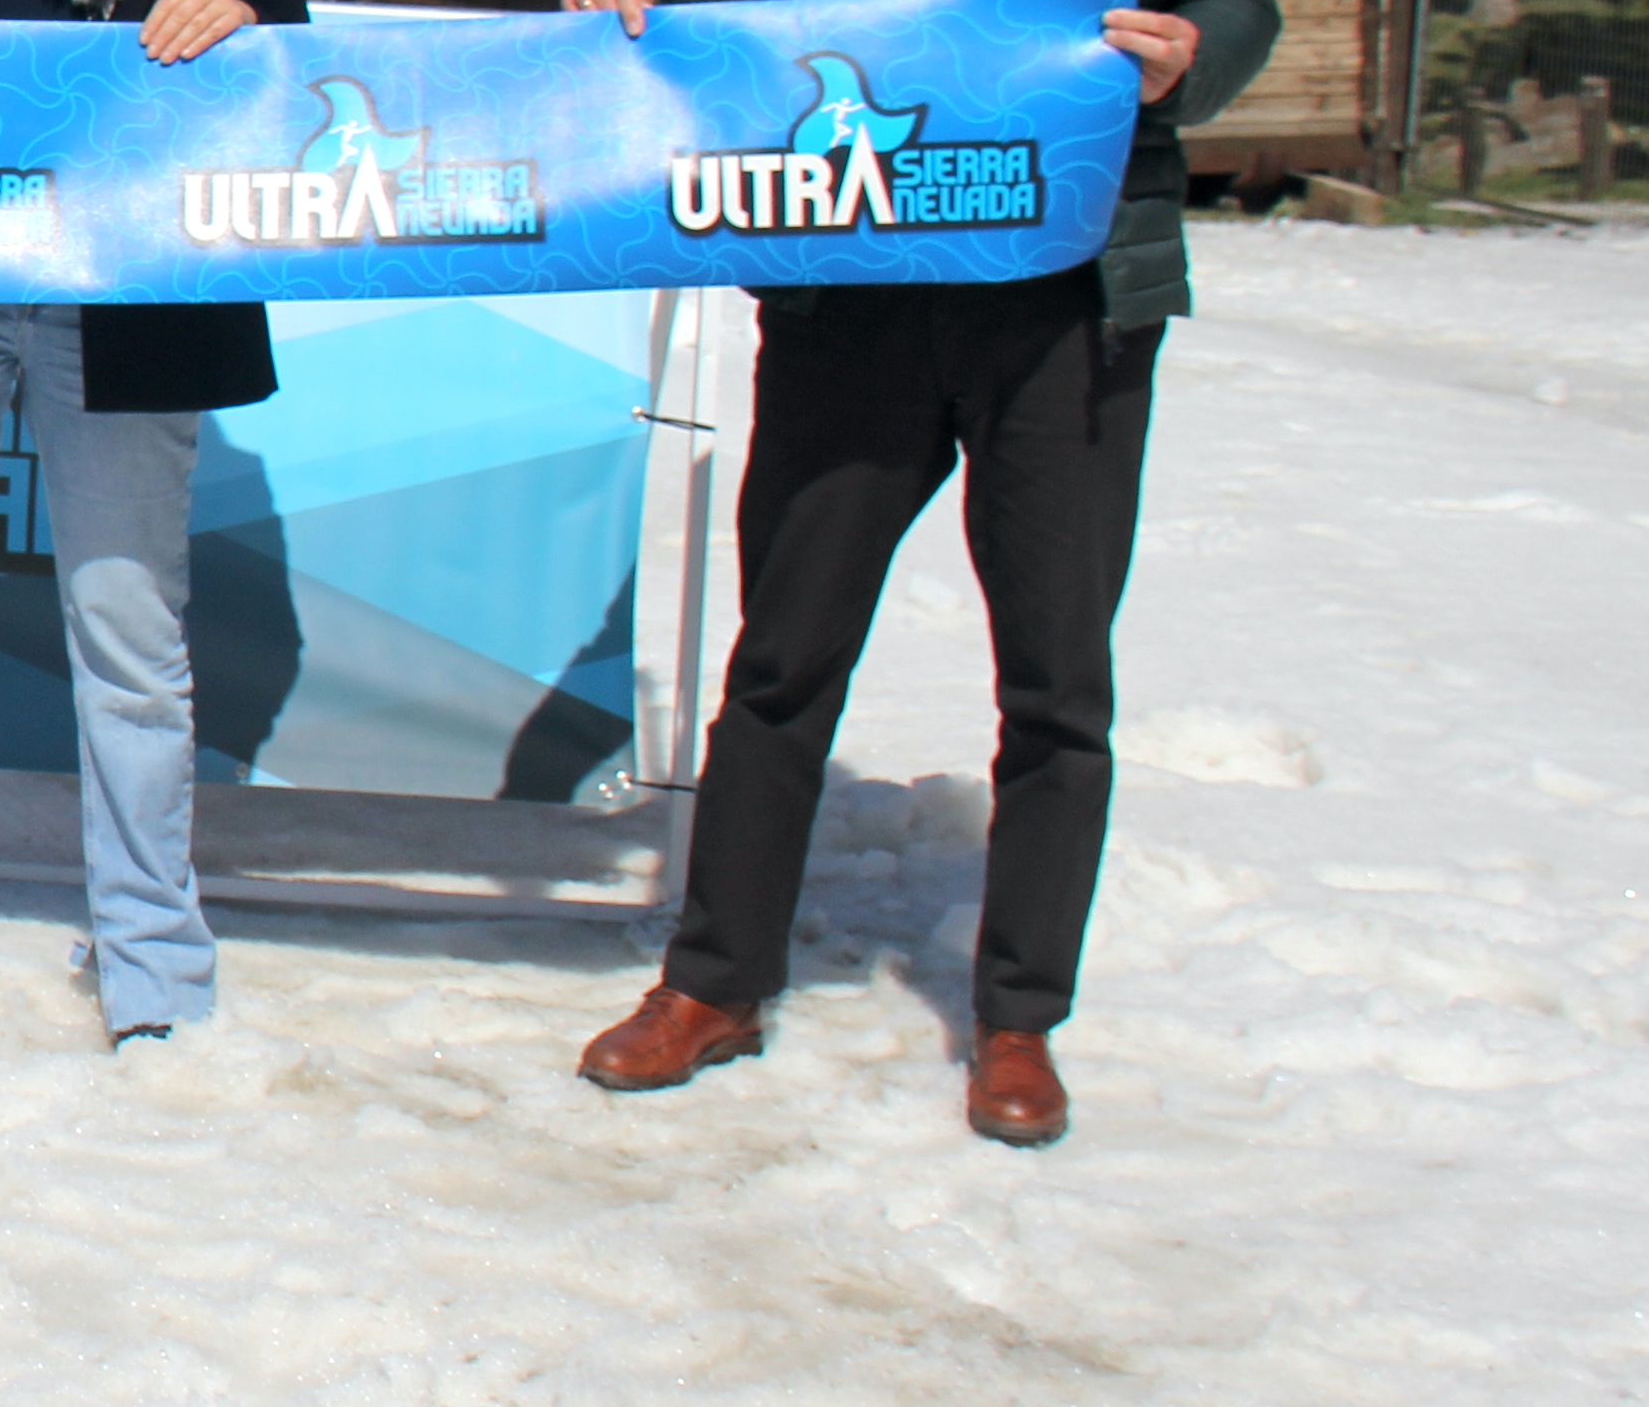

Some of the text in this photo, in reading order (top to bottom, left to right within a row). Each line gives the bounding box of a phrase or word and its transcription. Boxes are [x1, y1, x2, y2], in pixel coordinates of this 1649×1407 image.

[397, 165, 529, 201] SIERRA
[672, 121, 896, 230] ULTRA
[893, 146, 1030, 186] SIERRA
[184, 143, 398, 242] ULTRA
[893, 183, 1036, 223] NEVADA
